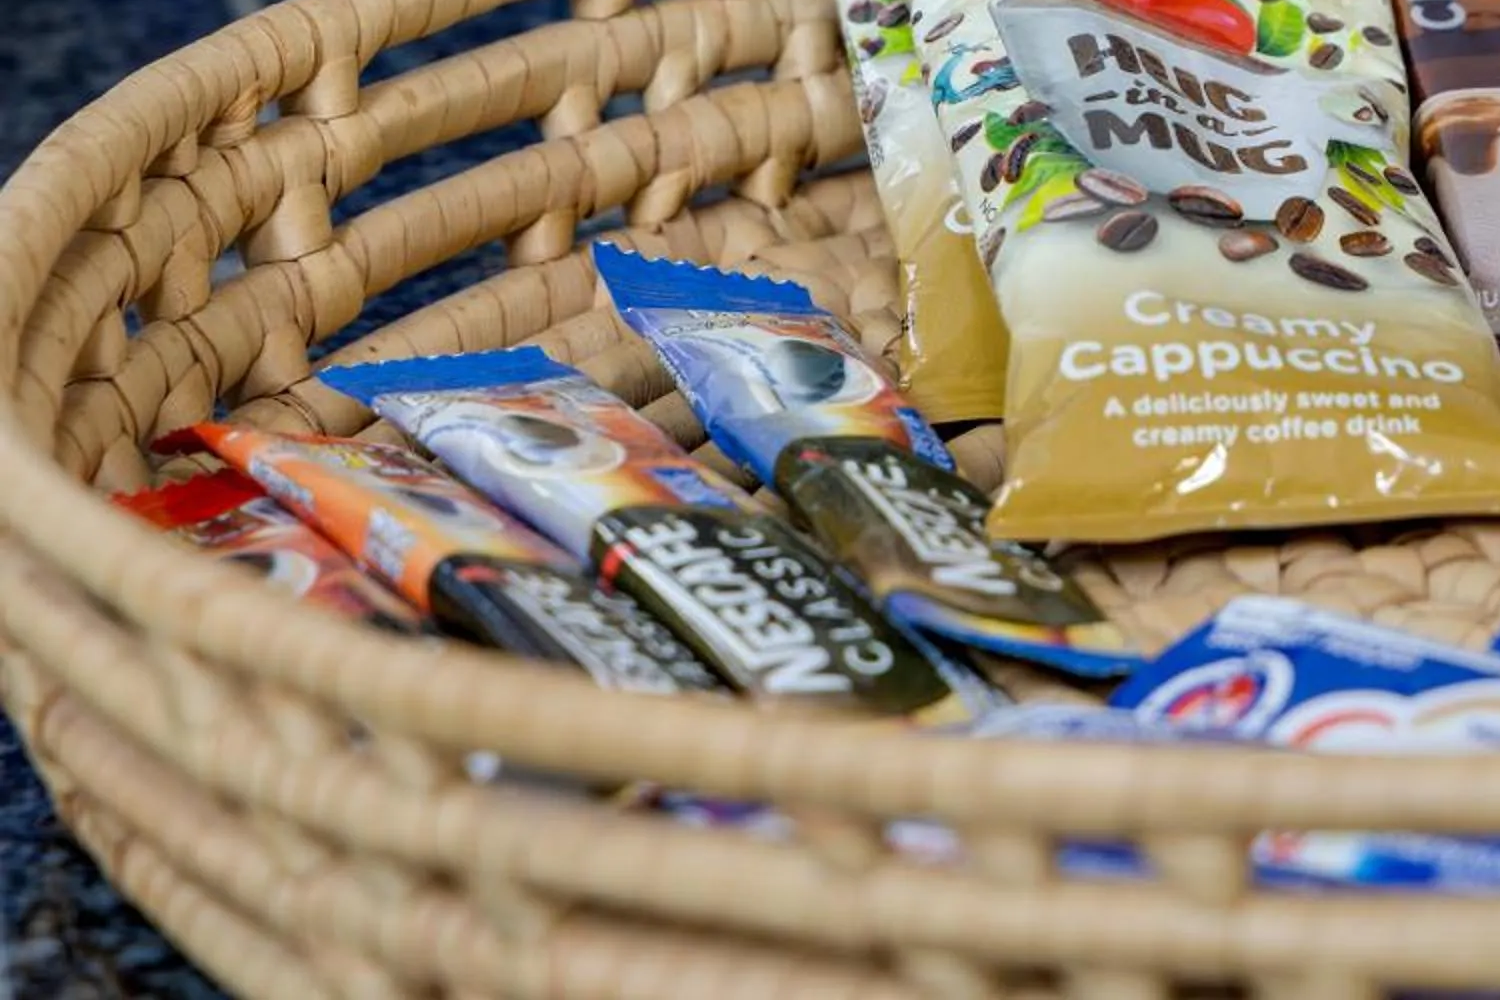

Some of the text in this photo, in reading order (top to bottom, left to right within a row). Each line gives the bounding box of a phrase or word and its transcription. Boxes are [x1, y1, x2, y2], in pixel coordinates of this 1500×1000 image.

[1067, 33, 1267, 122] HUG
[1083, 109, 1308, 175] MUG
[1123, 289, 1376, 345] Creamy
[1058, 340, 1465, 384] Cappuccino
[1103, 388, 1442, 419] A deliciously sweet and
[1132, 412, 1422, 448] creamy coffee drink
[717, 525, 896, 677] CLASSIC
